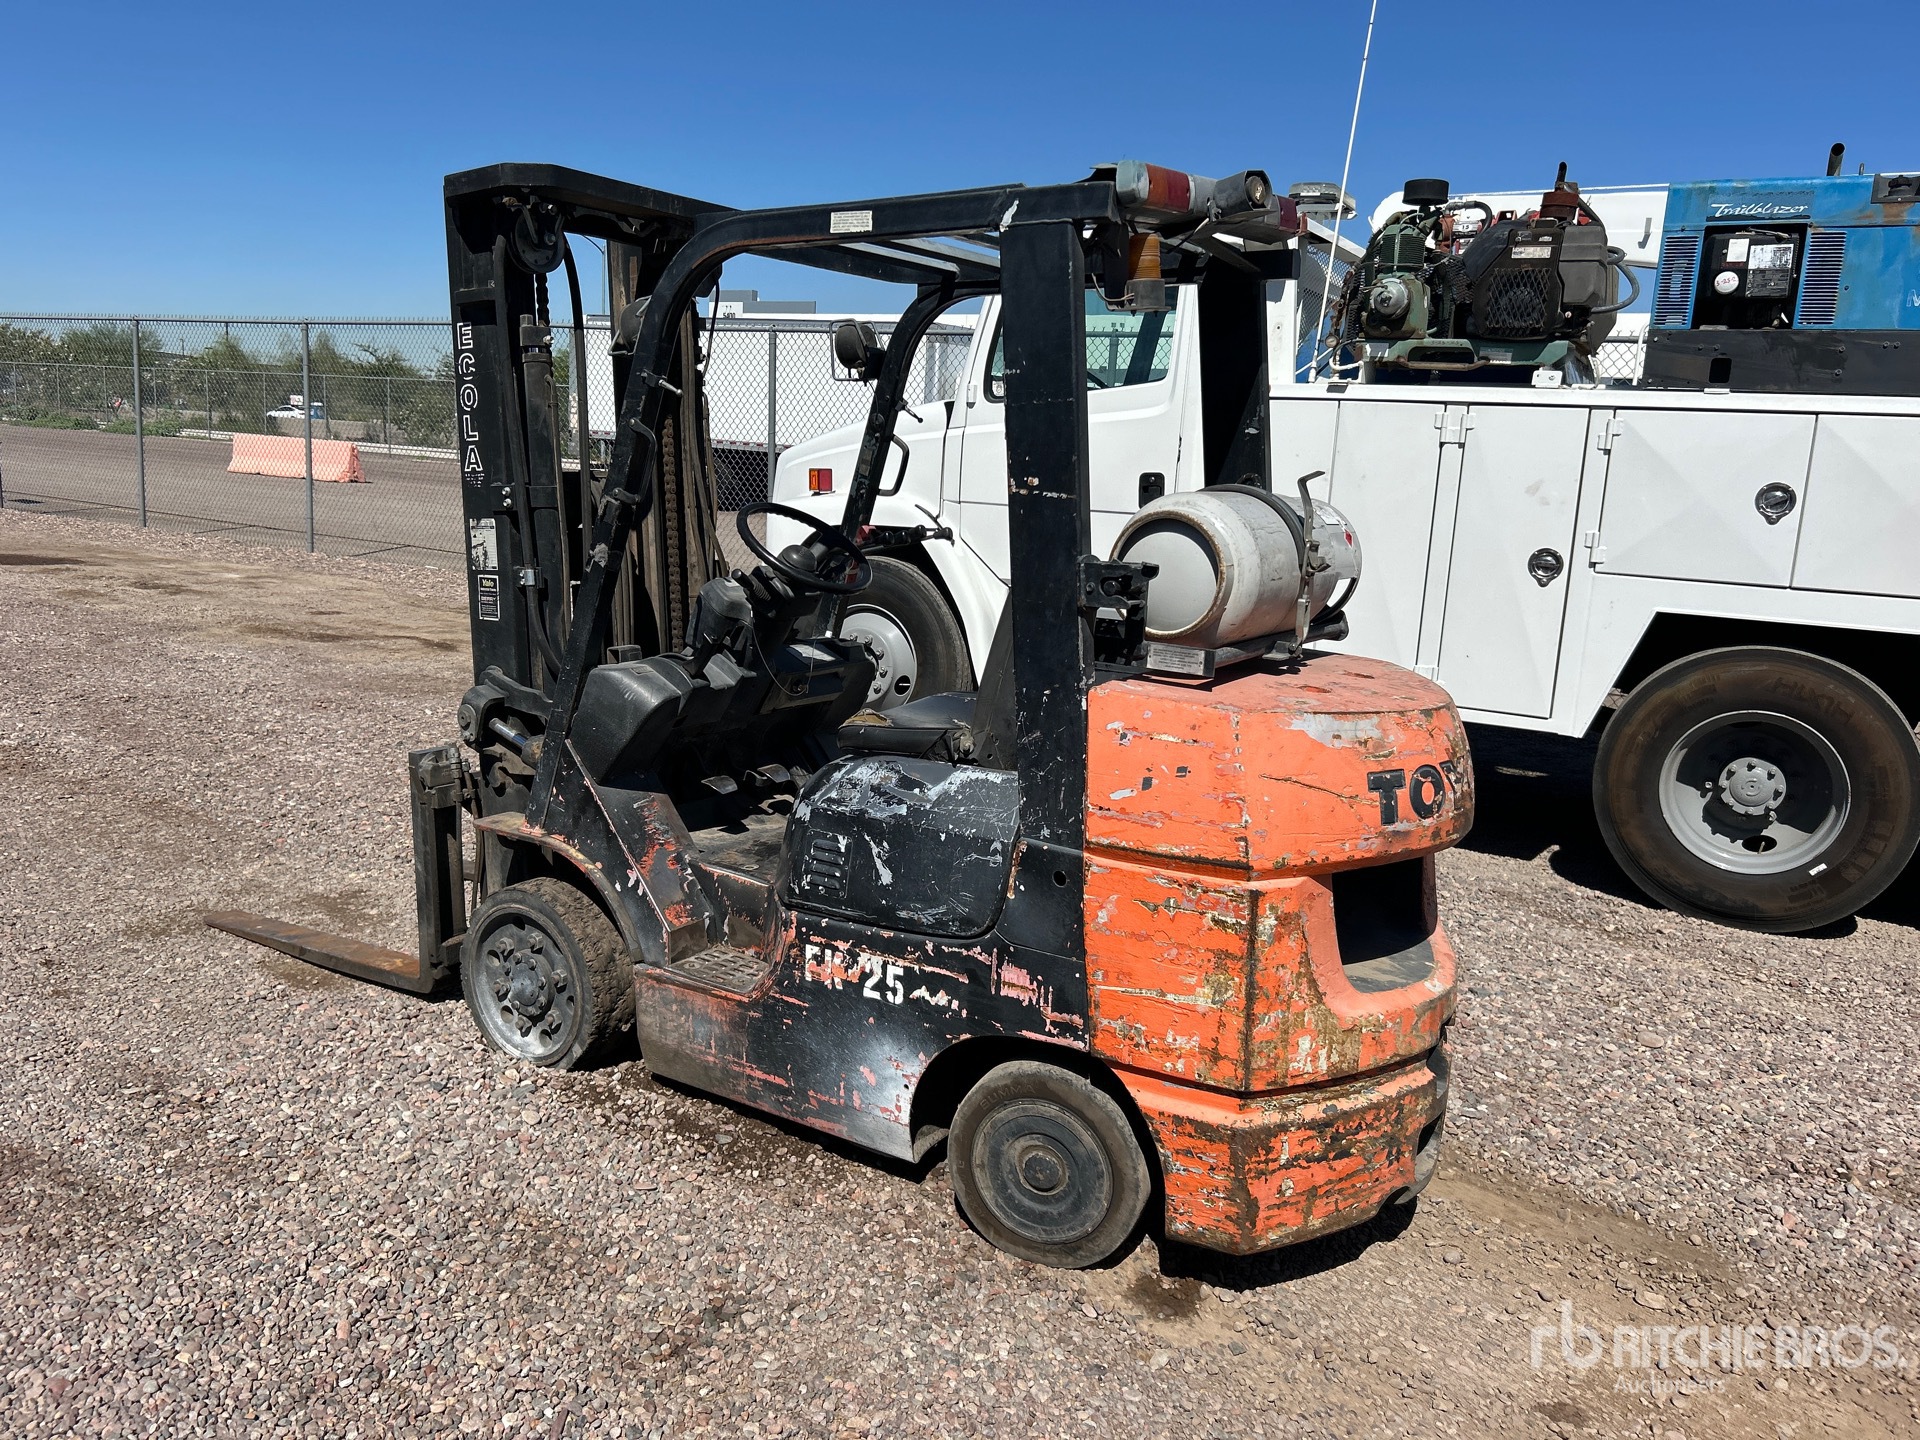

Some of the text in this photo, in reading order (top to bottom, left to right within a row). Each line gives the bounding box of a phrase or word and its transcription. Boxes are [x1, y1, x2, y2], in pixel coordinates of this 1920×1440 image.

[1711, 203, 1808, 217] Trailblazer
[457, 322, 484, 487] ECOLA
[863, 952, 904, 1005] 25
